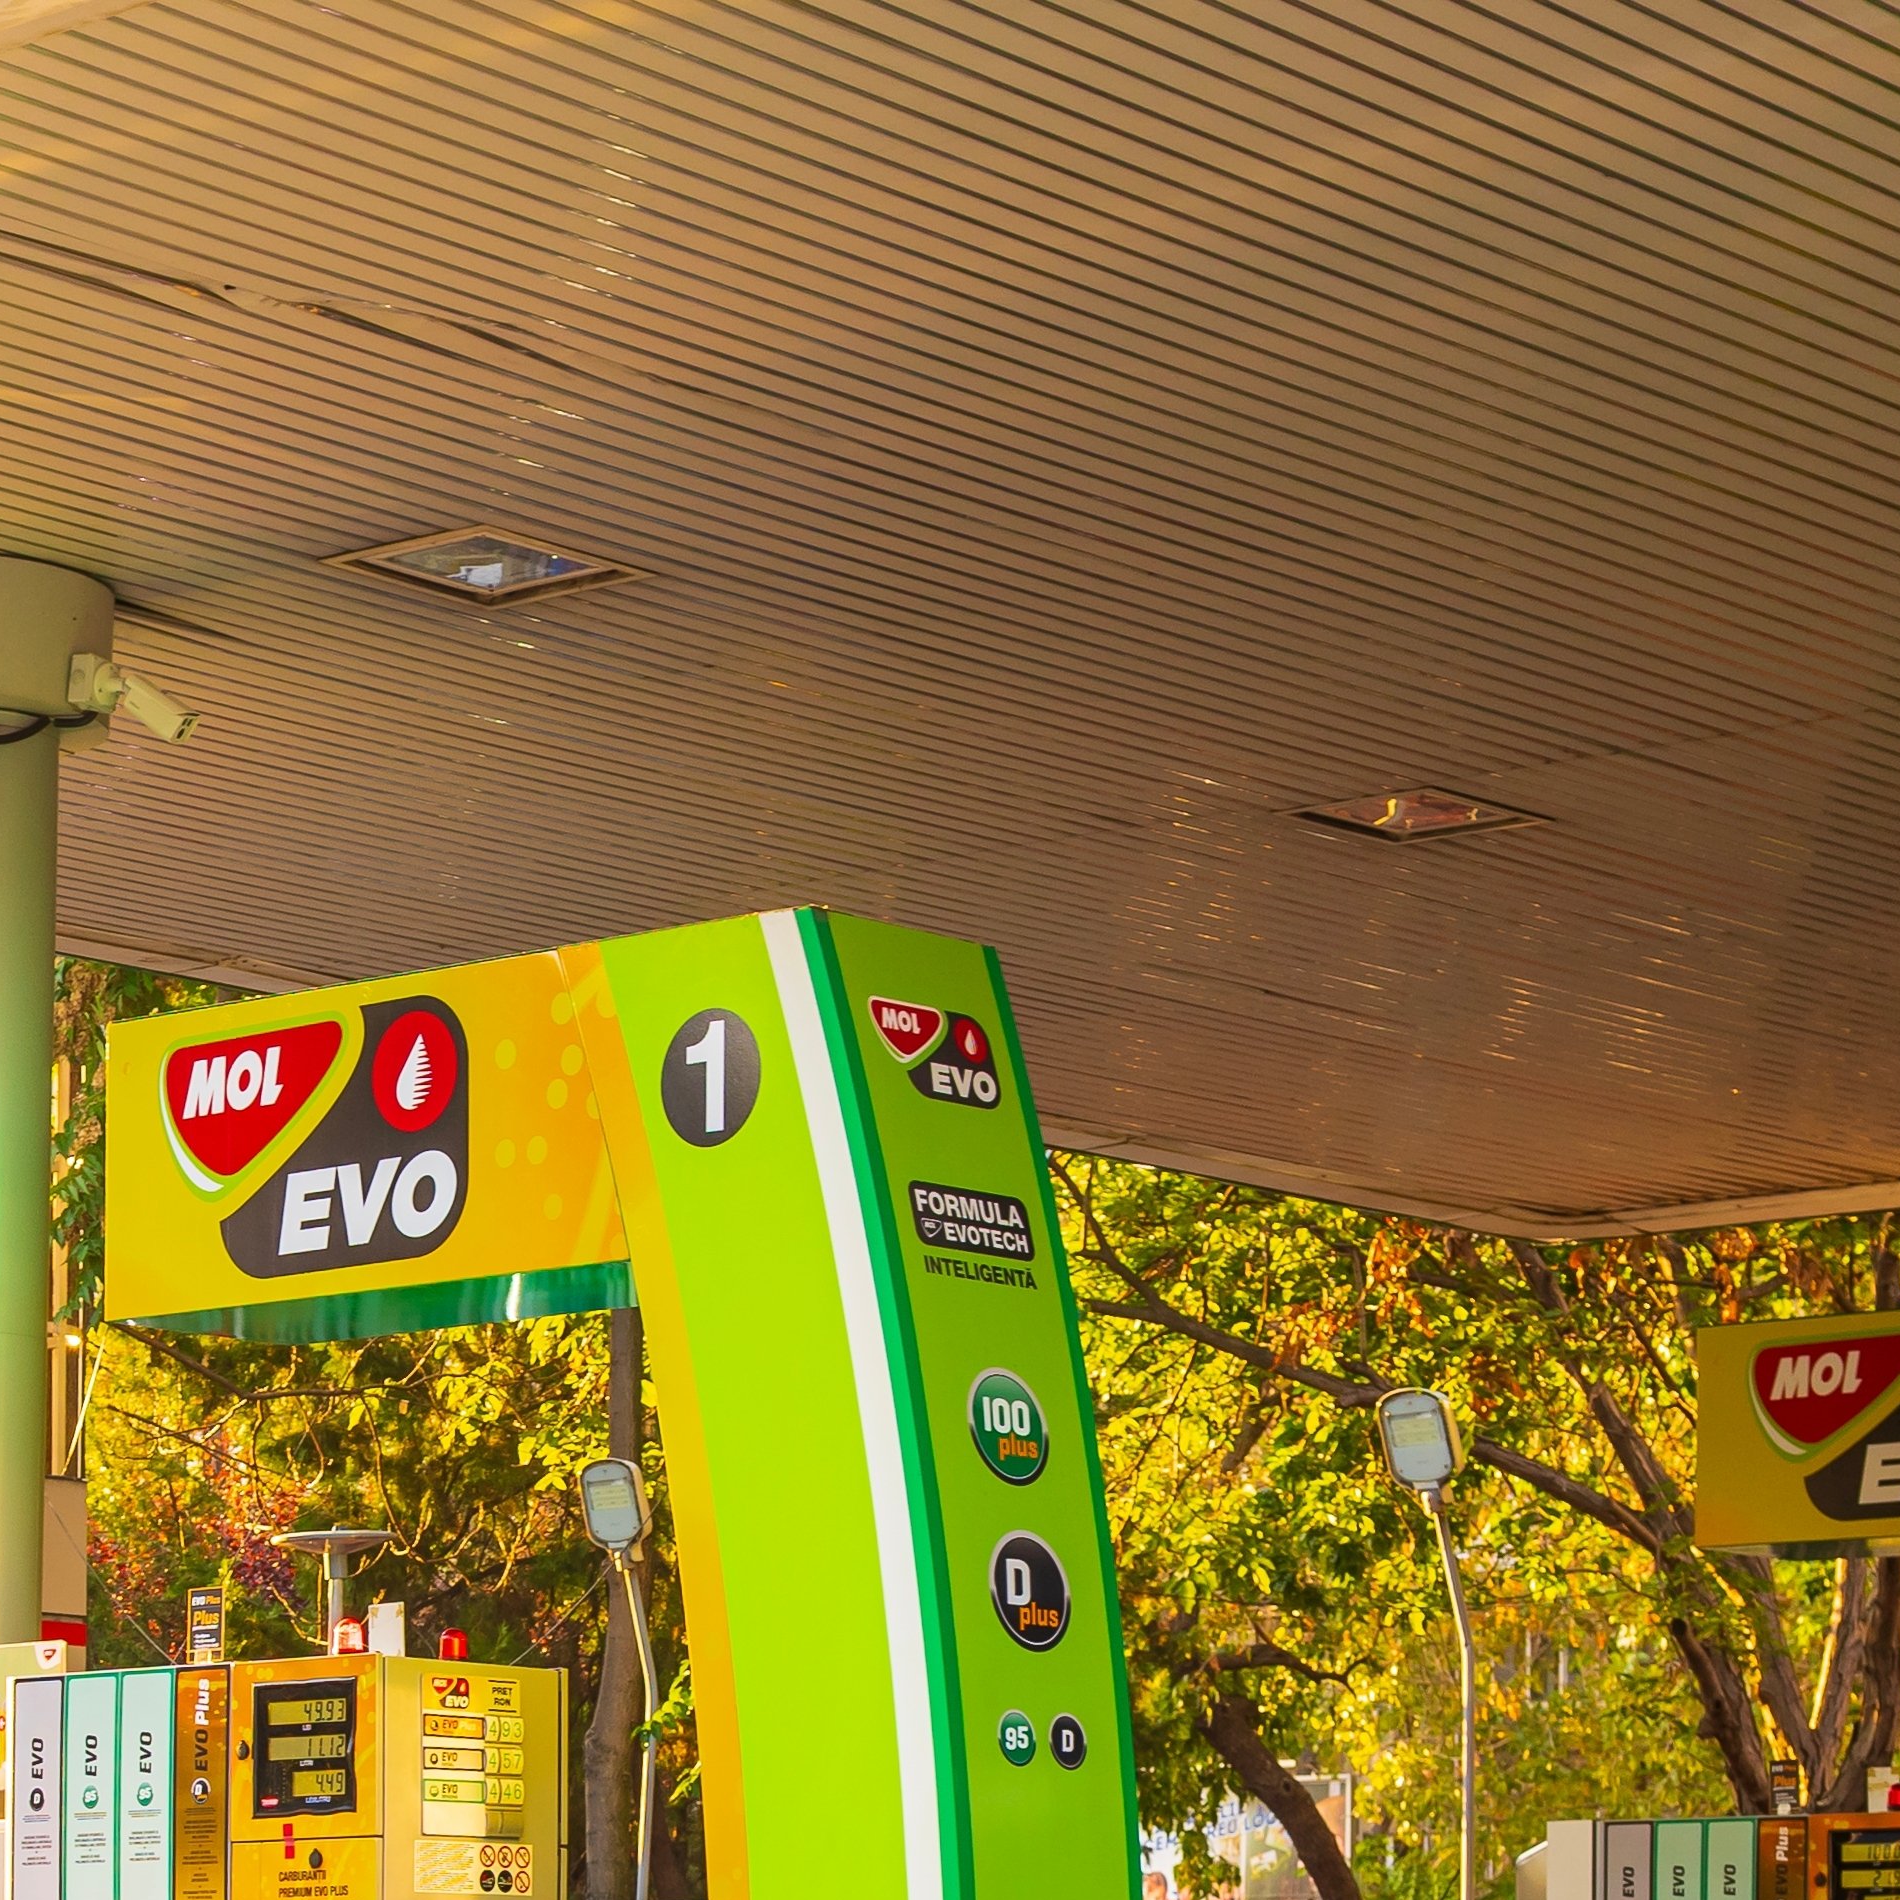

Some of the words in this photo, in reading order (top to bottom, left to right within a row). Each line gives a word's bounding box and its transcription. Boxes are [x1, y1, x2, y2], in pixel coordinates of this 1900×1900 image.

[882, 1007, 920, 1034] MOL
[183, 1047, 284, 1119] MOL
[686, 1021, 728, 1133] 1
[931, 1062, 996, 1102] EVO
[278, 1150, 458, 1255] EVO
[914, 1188, 1025, 1229] FORMULA
[943, 1222, 1029, 1254] EVOTECH
[924, 1255, 1038, 1290] INTELIGENTĂ
[1770, 1351, 1862, 1400] MOL
[983, 1396, 1030, 1436] 100
[998, 1433, 1038, 1461] plus
[1006, 1558, 1031, 1605] D
[193, 1610, 219, 1625] Plus
[1020, 1601, 1059, 1630] plus
[195, 1678, 209, 1726] Plus
[445, 1695, 469, 1708] EVO
[494, 1698, 511, 1706] RON
[442, 1720, 458, 1730] EVO
[1005, 1727, 1029, 1750] 95
[1062, 1729, 1074, 1753] D
[31, 1738, 44, 1780] EVO
[85, 1735, 98, 1777] EVO
[139, 1731, 153, 1774] EVO
[195, 1728, 209, 1772] EVO
[442, 1751, 458, 1761] EVO
[442, 1783, 458, 1794] EVO
[1775, 1826, 1789, 1862] Plus
[278, 1887, 312, 1898] PREMIUM
[314, 1886, 329, 1897] EVO
[330, 1885, 349, 1896] PLUS
[1622, 1866, 1635, 1898] EVO
[1673, 1865, 1685, 1897] EVO
[1724, 1864, 1737, 1896] EVO
[1775, 1863, 1788, 1896] EVO
